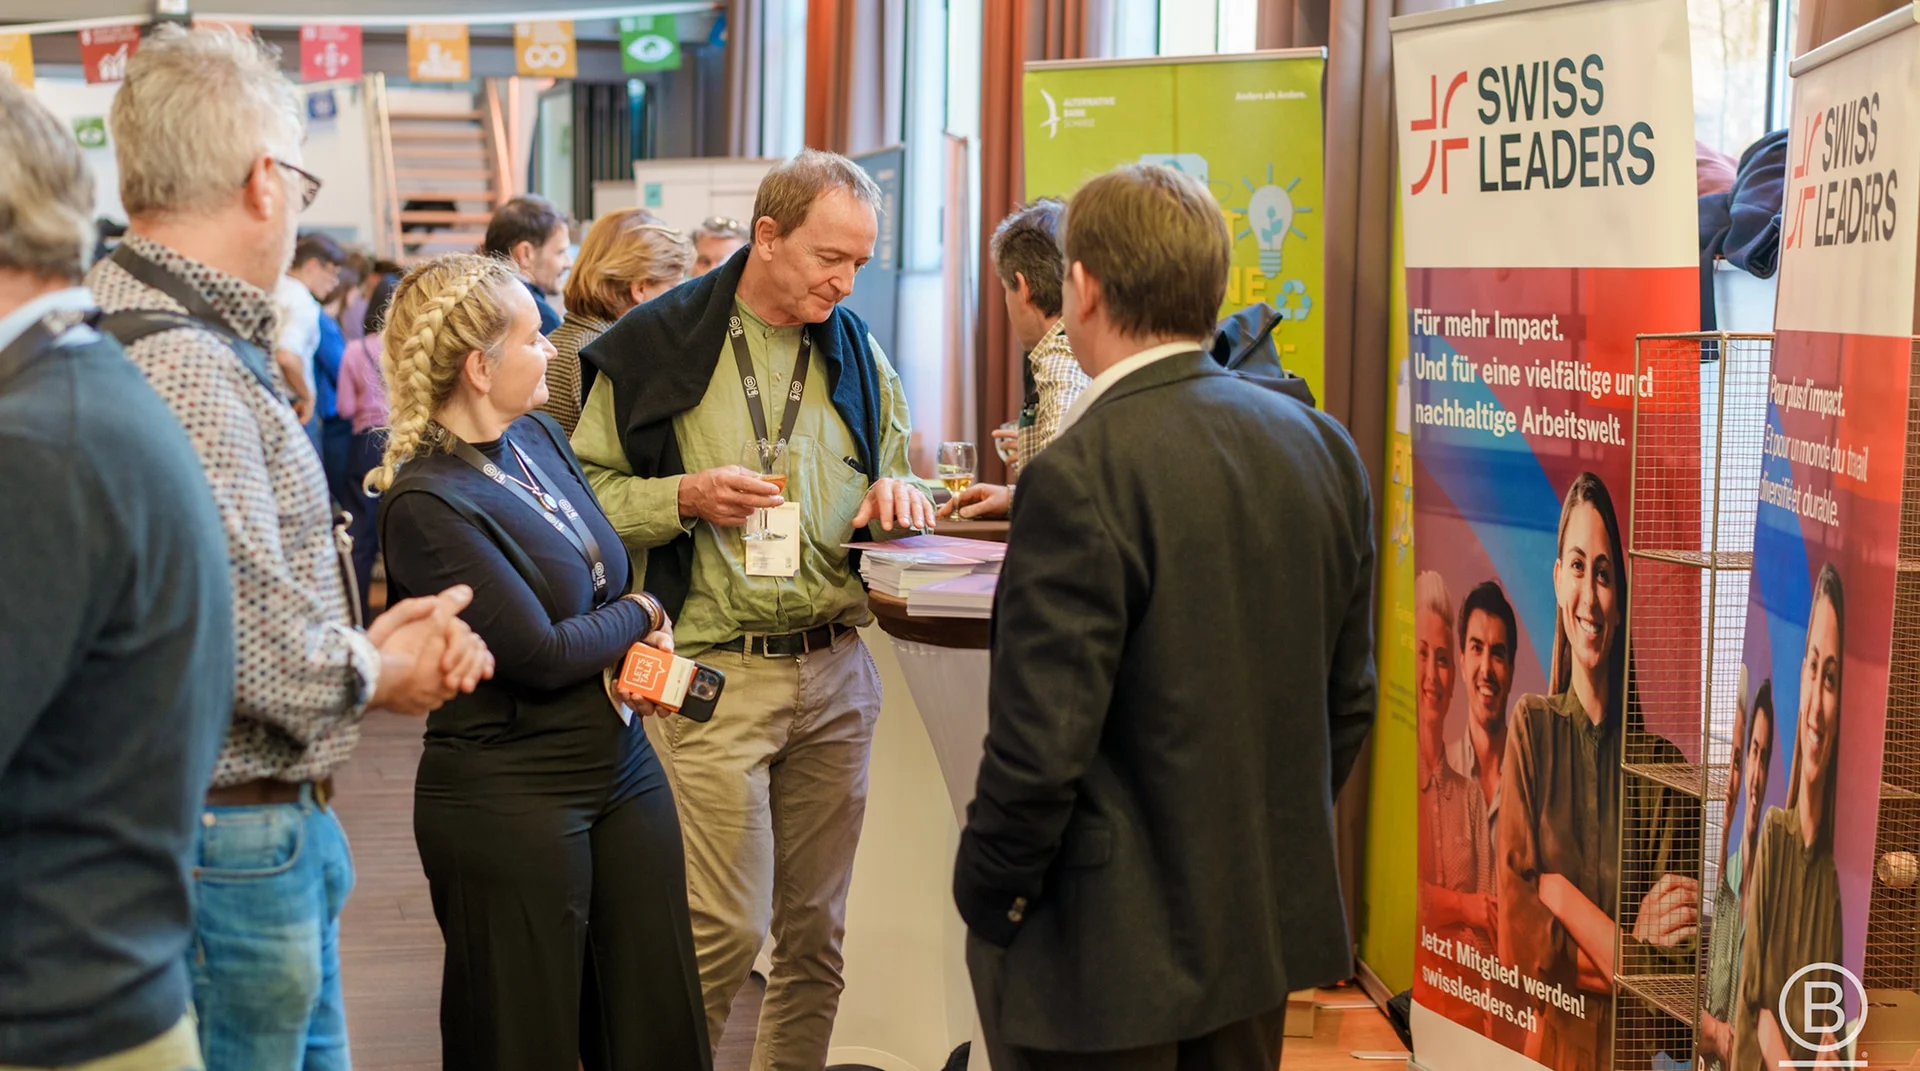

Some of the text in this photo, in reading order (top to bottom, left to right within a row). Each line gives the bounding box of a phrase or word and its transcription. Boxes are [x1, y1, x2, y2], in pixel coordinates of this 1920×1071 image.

[1477, 53, 1604, 125] SWISS
[1479, 121, 1656, 192] LEADERS
[1822, 91, 1880, 172] SWISS
[1814, 169, 1898, 248] LEADERS
[1414, 308, 1564, 345] Für mehr Impact.
[1415, 352, 1653, 399] Und für eine vielfältige und
[1769, 374, 1788, 406] Pour
[1415, 398, 1625, 446] nachhaltige Arbeitswelt.
[1764, 423, 1773, 455] Et
[1772, 432, 1791, 462] pour
[1799, 435, 1830, 470] monde
[1830, 438, 1845, 474] du
[1802, 484, 1840, 527] durable.
[640, 660, 655, 683] TALK
[1422, 925, 1586, 1019] Jetzt Mitglied werden!
[1422, 965, 1537, 1034] swissleaders.ch
